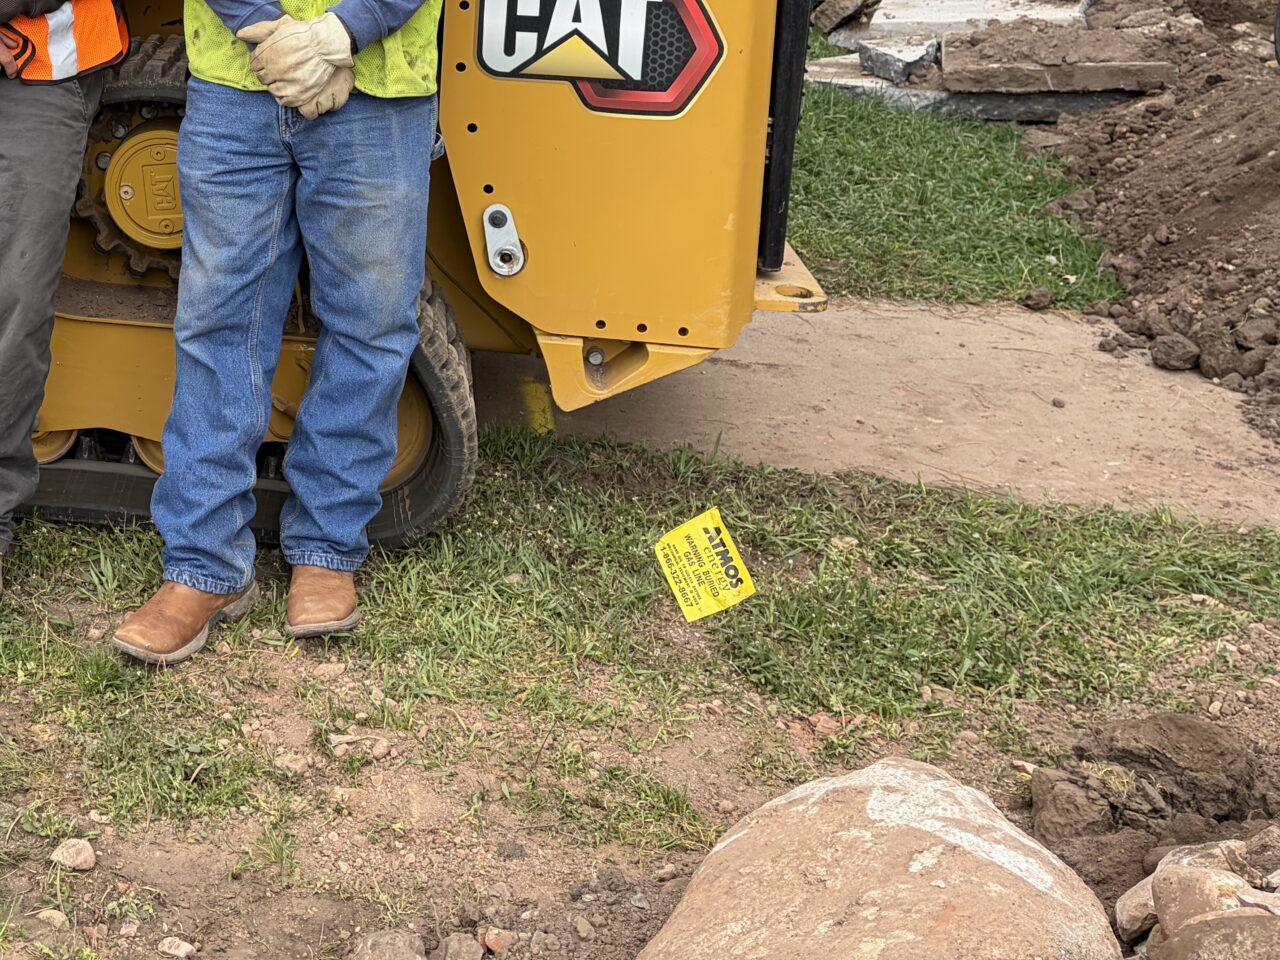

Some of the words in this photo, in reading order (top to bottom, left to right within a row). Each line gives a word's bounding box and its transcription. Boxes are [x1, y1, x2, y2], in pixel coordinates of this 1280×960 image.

[150, 175, 177, 210] CAT
[660, 546, 694, 608] 1-866-322-8667
[683, 551, 696, 567] GAS
[692, 568, 706, 587] LINE
[684, 533, 706, 568] WARNING
[702, 570, 720, 598] BURIED
[703, 526, 744, 589] ATMOS
[703, 546, 731, 591] energy
